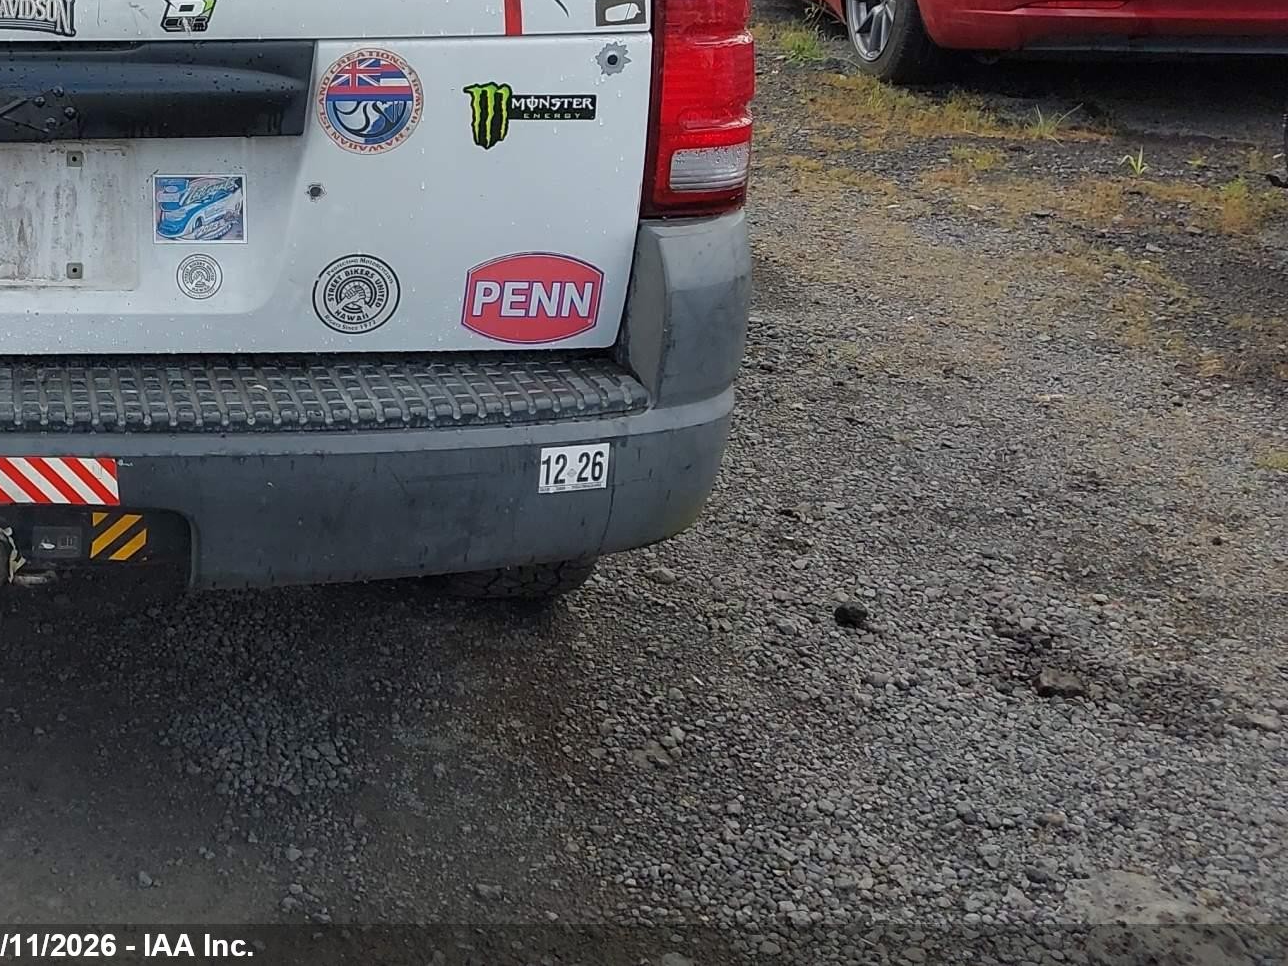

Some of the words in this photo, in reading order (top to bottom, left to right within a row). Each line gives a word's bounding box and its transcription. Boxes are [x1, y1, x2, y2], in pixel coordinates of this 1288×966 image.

[327, 275, 343, 302] STREET
[344, 268, 375, 280] BIKERS
[374, 278, 385, 308] UNITED
[472, 281, 594, 318] PENN
[334, 309, 369, 321] HAWAII
[542, 453, 568, 486] 12
[576, 450, 605, 483] 26
